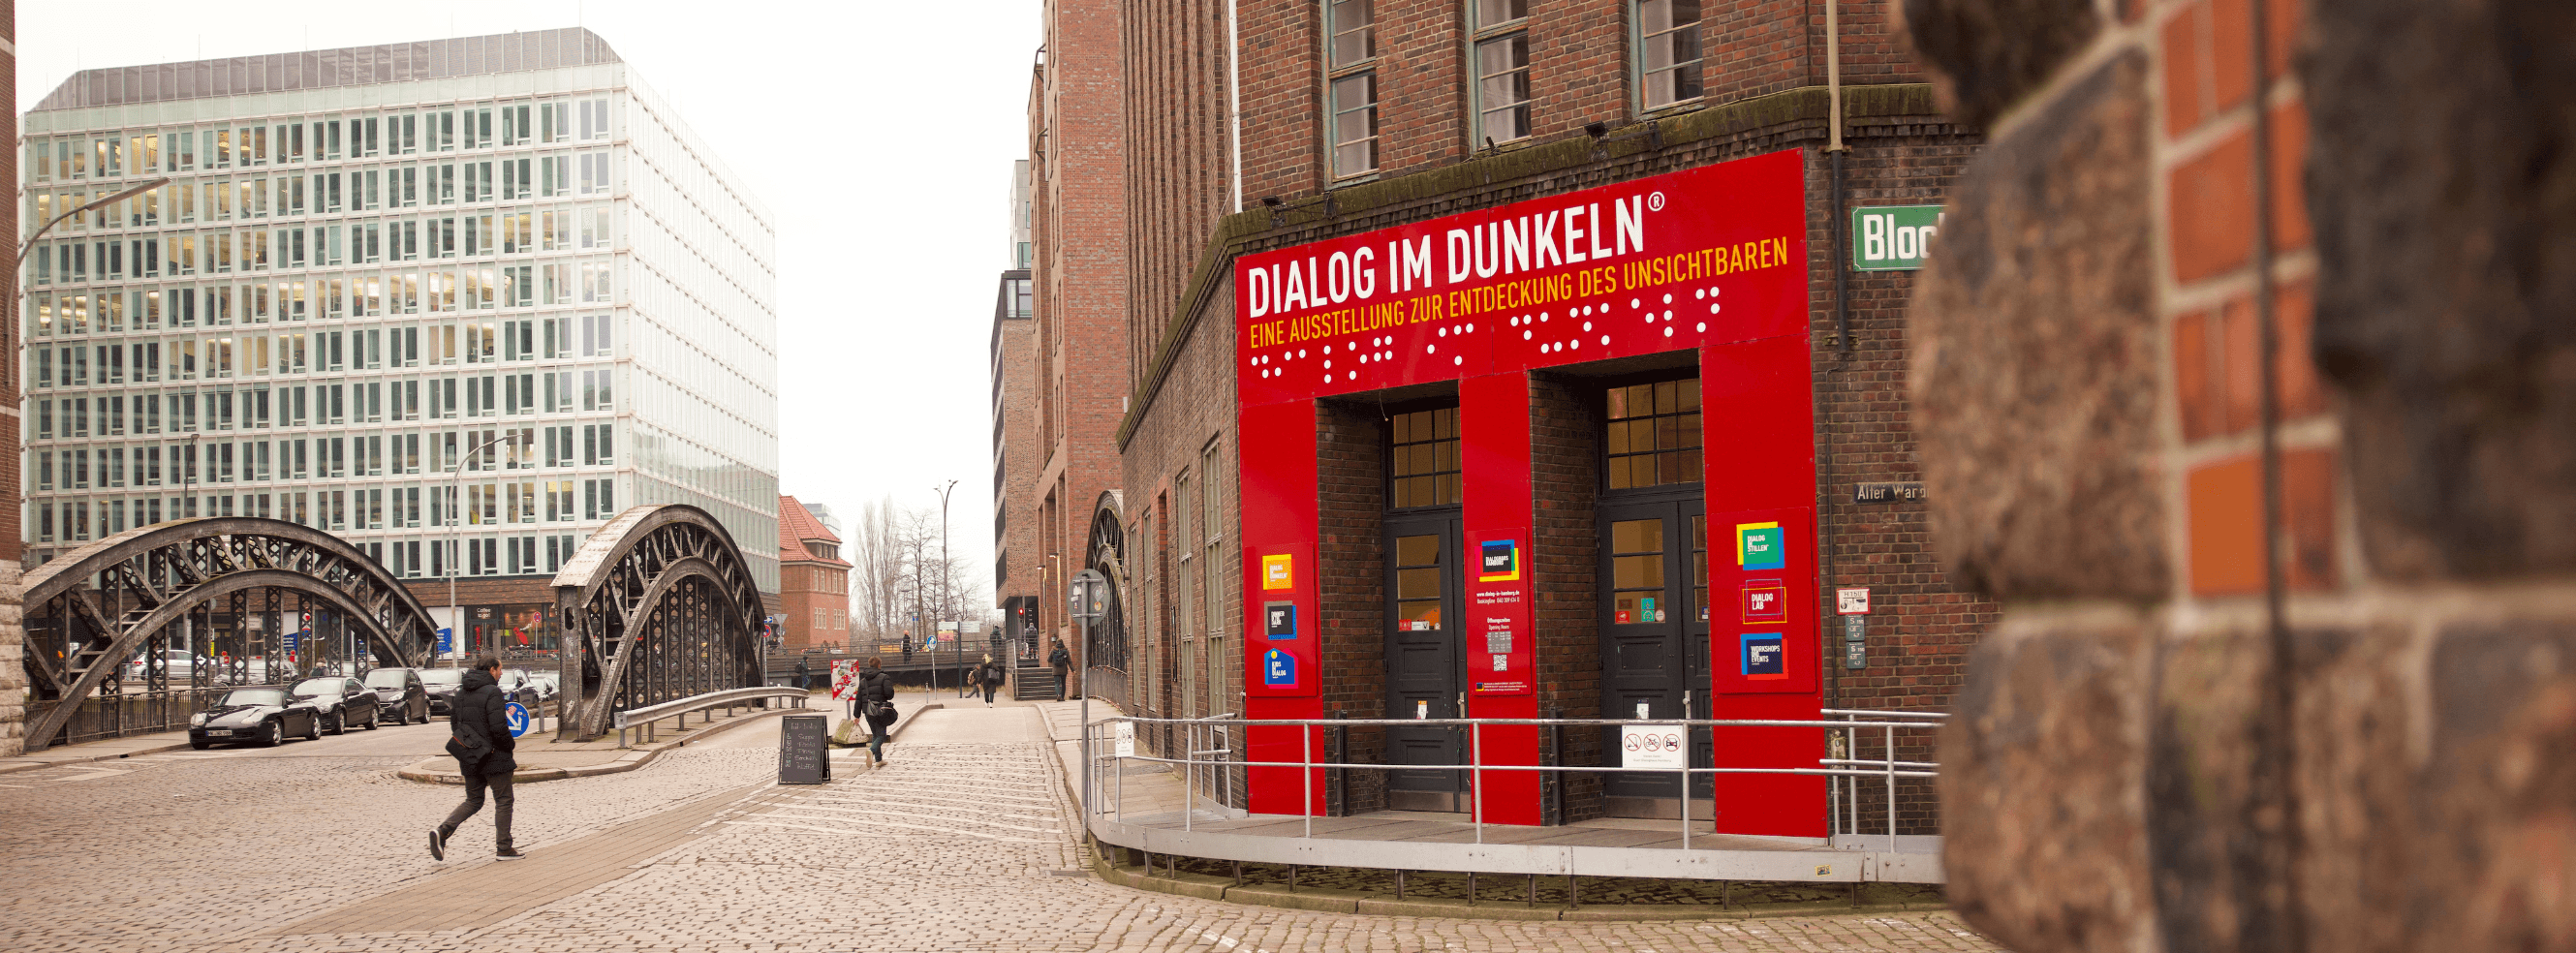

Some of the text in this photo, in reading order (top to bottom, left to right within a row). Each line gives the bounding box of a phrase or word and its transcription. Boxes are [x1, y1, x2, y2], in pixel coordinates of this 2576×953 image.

[1863, 212, 1945, 261] Bloc
[1249, 246, 1377, 318] DIALOG
[1388, 234, 1432, 292] IM
[1250, 236, 1787, 349] EINE AUSSTELLUNG ZUR ENTDECKUNG DES UNSICHTBAREN
[1857, 484, 1886, 500] Alter
[1752, 593, 1773, 601] DIALOG
[1752, 601, 1764, 610] LAB
